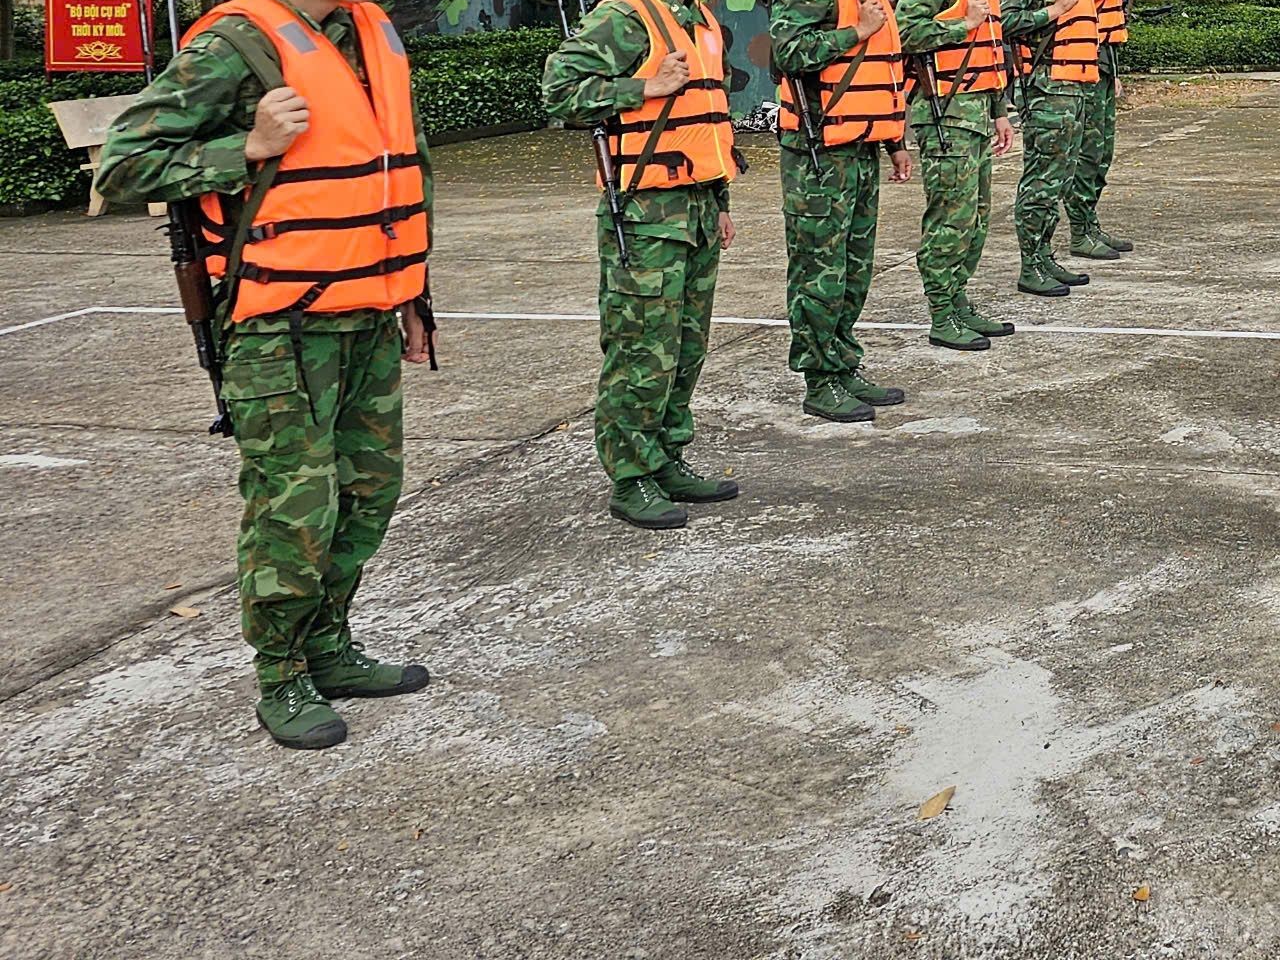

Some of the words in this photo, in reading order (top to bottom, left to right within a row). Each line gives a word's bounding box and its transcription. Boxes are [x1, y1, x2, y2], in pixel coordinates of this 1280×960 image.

[84, 3, 99, 20] ĐỘI
[100, 6, 113, 20] CỤ
[71, 22, 91, 37] THỜI
[92, 22, 104, 37] KỲ
